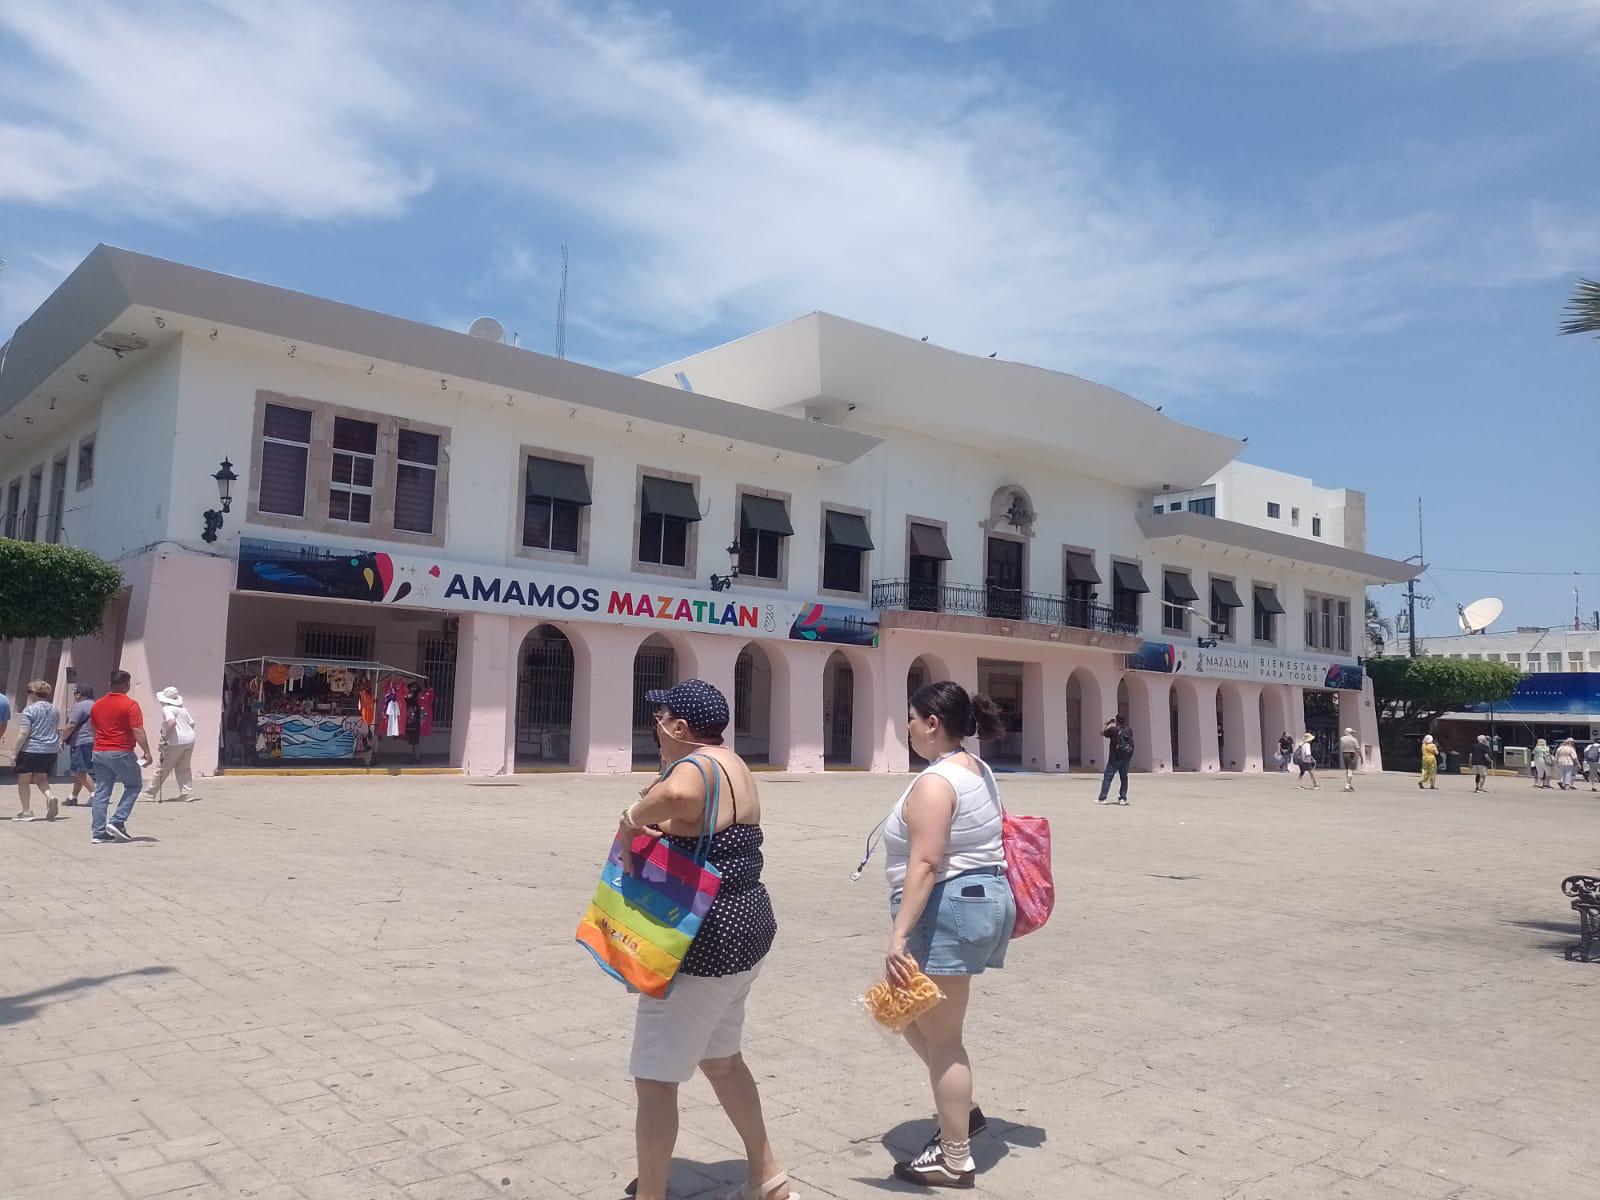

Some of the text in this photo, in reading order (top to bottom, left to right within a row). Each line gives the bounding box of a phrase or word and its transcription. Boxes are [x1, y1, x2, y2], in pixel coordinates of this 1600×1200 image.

[444, 573, 758, 628] AMAMOS MAZATLÁN
[1260, 658, 1318, 671] BIENESTAR
[1260, 669, 1283, 678] PARA
[1289, 672, 1318, 682] TODOS
